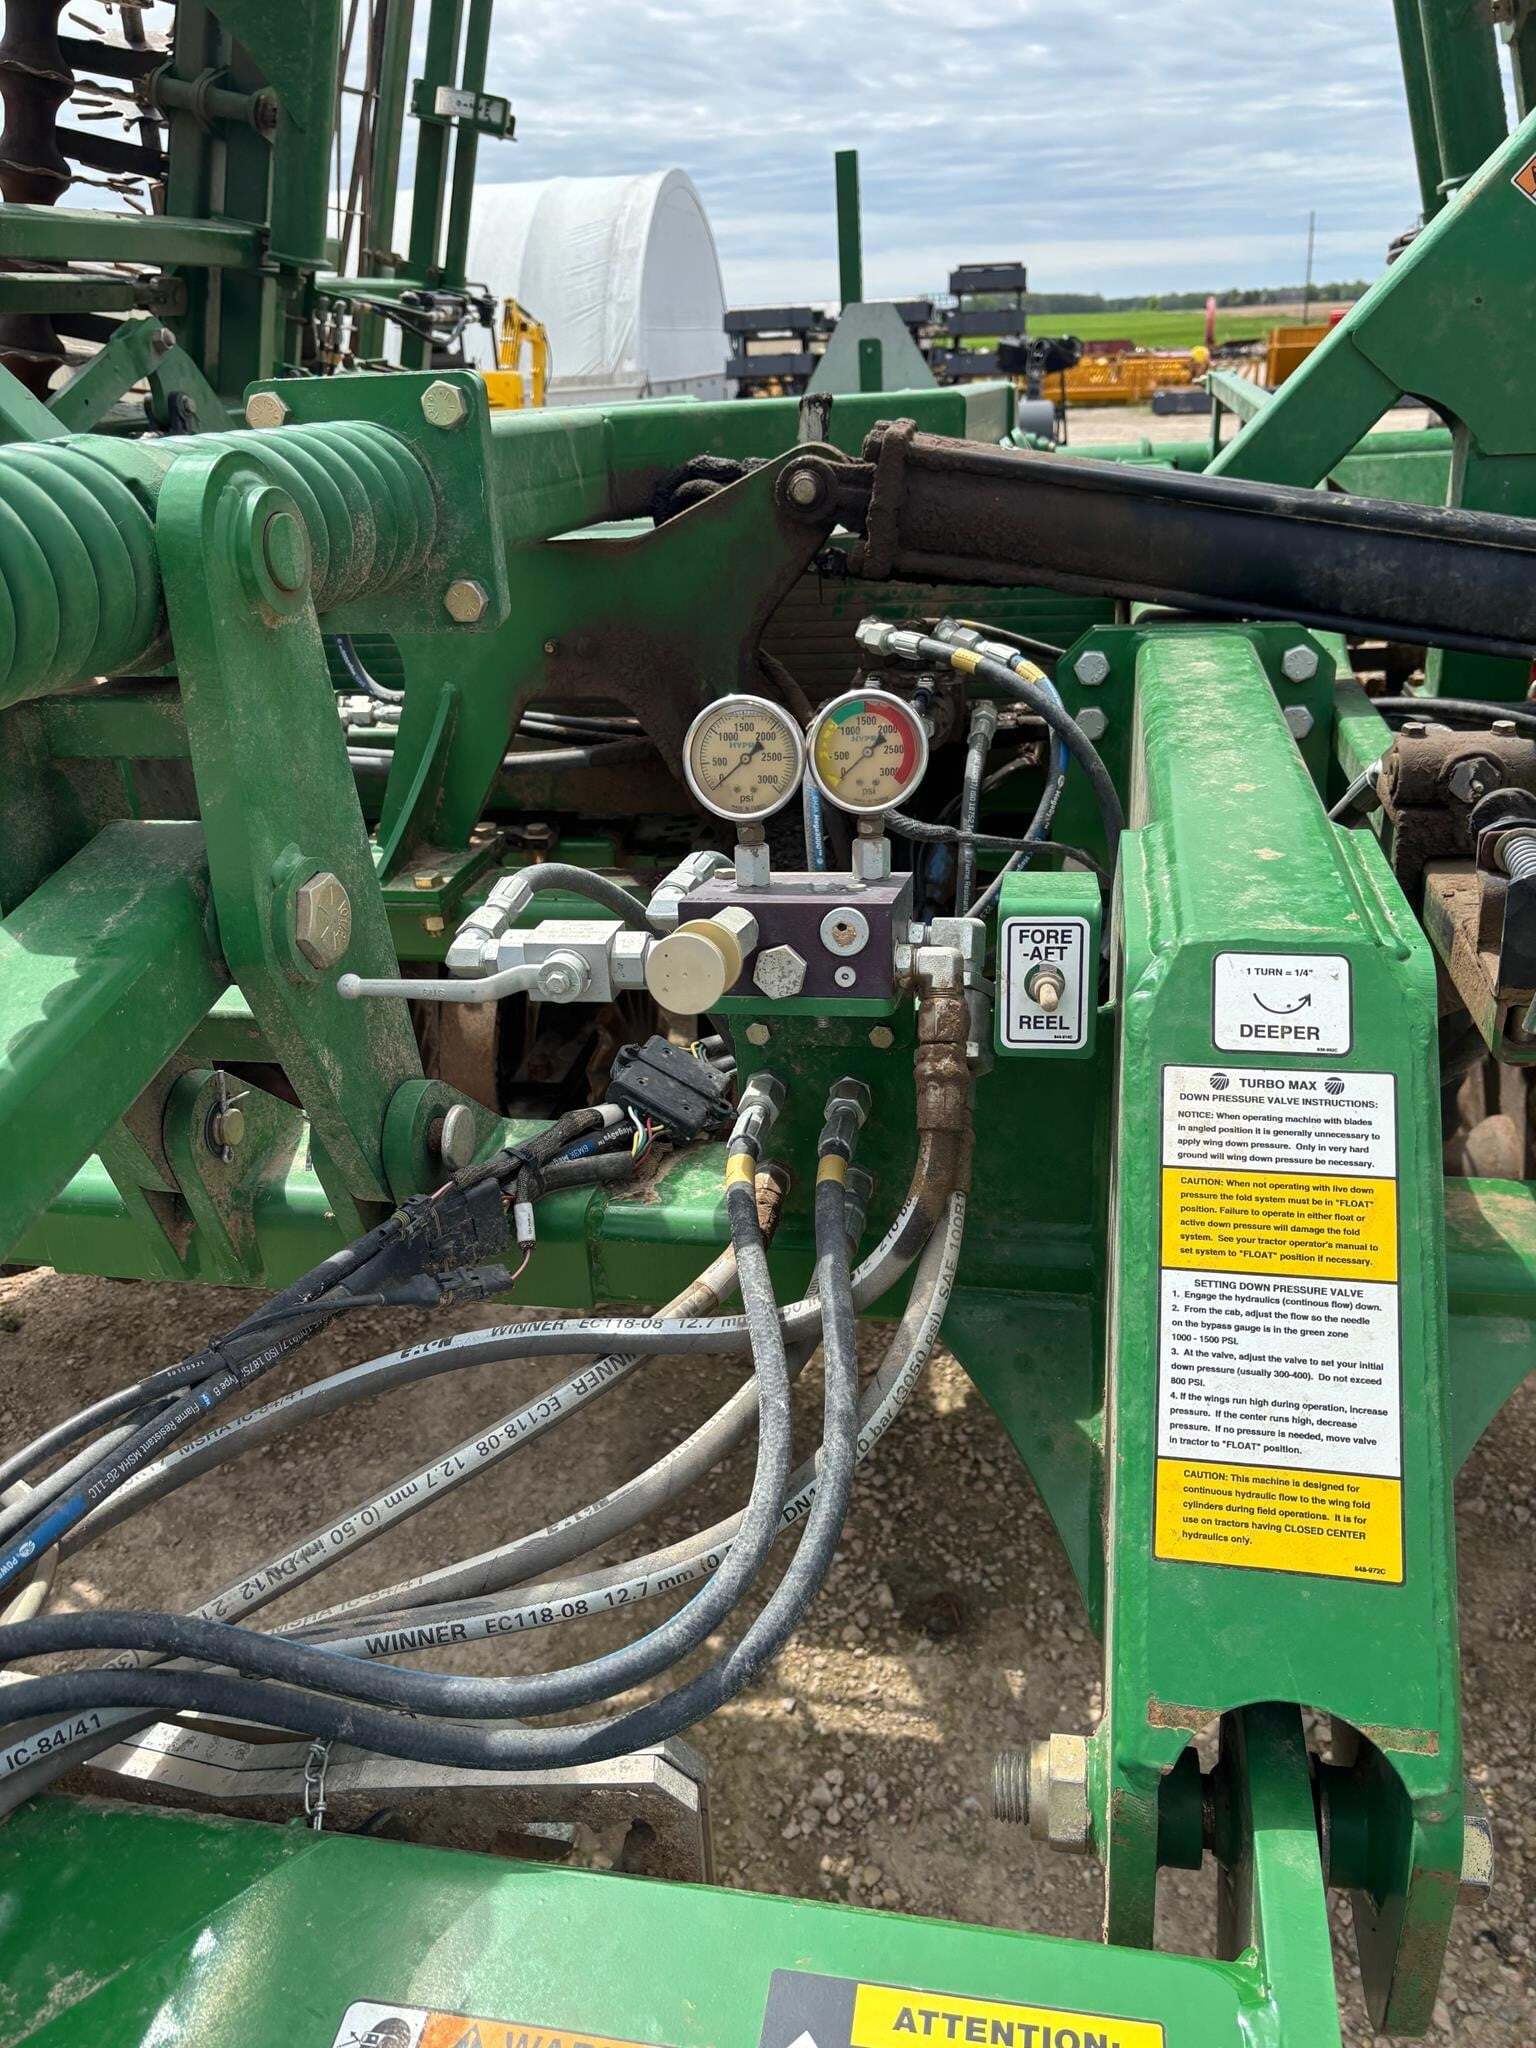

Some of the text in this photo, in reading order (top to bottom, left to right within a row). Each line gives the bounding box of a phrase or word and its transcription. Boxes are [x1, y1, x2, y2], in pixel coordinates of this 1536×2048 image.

[734, 722, 755, 732] 1500
[857, 716, 877, 725] 1500
[719, 732, 739, 741] 1000
[756, 732, 776, 741] 2000
[841, 726, 860, 735] 1000
[877, 725, 898, 734] 2000
[761, 752, 783, 762] 2500
[834, 752, 850, 760] 500
[884, 745, 904, 754] 2500
[712, 757, 728, 766] 500
[757, 775, 778, 784] 3000
[840, 767, 846, 776] 0
[740, 795, 754, 803] psi
[1019, 929, 1073, 944] FORE
[1023, 946, 1068, 961] -AFT
[1246, 967, 1251, 975] 1
[1254, 967, 1282, 976] TURN
[1019, 1015, 1070, 1030] REEL
[1240, 1024, 1320, 1040] DEEPER
[1238, 1078, 1317, 1090] TURBO MAX
[1179, 1093, 1378, 1108] DOWN PRESSURE VALVE INSTRUCTIONS:
[1177, 1110, 1214, 1118] NOTICE:
[1215, 1112, 1240, 1120] When
[1242, 1114, 1283, 1123] operating
[1343, 1118, 1372, 1126] blades
[1187, 1125, 1216, 1133] angled
[1218, 1126, 1253, 1134] position
[1263, 1127, 1271, 1135] is
[1272, 1129, 1312, 1138] generally
[1314, 1132, 1370, 1141] unnecessary
[1177, 1138, 1201, 1146] apply
[1202, 1138, 1223, 1148] wing
[1295, 1142, 1316, 1152] Only
[1318, 1143, 1326, 1151] in
[1328, 1146, 1348, 1154] very
[1349, 1145, 1369, 1153] hard
[1209, 1152, 1224, 1160] will
[1226, 1154, 1247, 1162] wing
[1249, 1154, 1273, 1162] down
[1315, 1157, 1326, 1165] be
[1328, 1159, 1375, 1169] necessary.
[1180, 1176, 1223, 1186] CAUTION:
[1226, 1179, 1250, 1187] When
[1268, 1183, 1310, 1192] operating
[1312, 1184, 1330, 1192] with
[1332, 1185, 1348, 1193] live
[1349, 1186, 1374, 1194] down
[1194, 1279, 1363, 1298] SETTING DOWN PRESSURE VALVE
[1172, 1290, 1180, 1298] 1.
[1184, 1290, 1217, 1301] Engage
[1218, 1293, 1233, 1301] the
[1234, 1294, 1280, 1304] hydraulics
[1331, 1300, 1353, 1310] flow)
[1354, 1302, 1382, 1311] down.
[1171, 1304, 1180, 1312] 2.
[1184, 1304, 1207, 1313] From
[1208, 1307, 1223, 1315] the
[1224, 1308, 1243, 1317] cab,
[1244, 1310, 1272, 1319] adjust
[1274, 1311, 1288, 1319] the
[1290, 1312, 1309, 1320] flow
[1324, 1314, 1338, 1322] the
[1340, 1317, 1370, 1325] needle
[1172, 1333, 1192, 1341] 1000
[1199, 1335, 1220, 1343] 1500
[869, 1407, 894, 1437] bar
[894, 1349, 927, 1406] (3050
[925, 1312, 942, 1346] psi)
[939, 1260, 956, 1300] SAE
[475, 1396, 562, 1457] EC118-08
[88, 1400, 200, 1499] Flame Resistant MSHA 2G-11C
[427, 1456, 465, 1489] 12.7
[1183, 1469, 1360, 1492] CAUTION: This machine is designed for
[384, 1482, 418, 1509] mm
[1182, 1486, 1370, 1509] continuous hydraulic flow to the wing fold
[1182, 1500, 1367, 1524] cylinders during field operations. It is for
[330, 1506, 381, 1546] (0.50
[1182, 1516, 1199, 1524] use
[1214, 1518, 1250, 1528] tractors
[1251, 1521, 1282, 1533] having
[1284, 1524, 1324, 1535] CLOSED
[1326, 1528, 1366, 1540] CENTER
[1182, 1530, 1252, 1546] hydraulics only.
[365, 1567, 694, 1656] WINNER EC118-08 12.7 mm
[6, 1713, 102, 1770] IC-84/41
